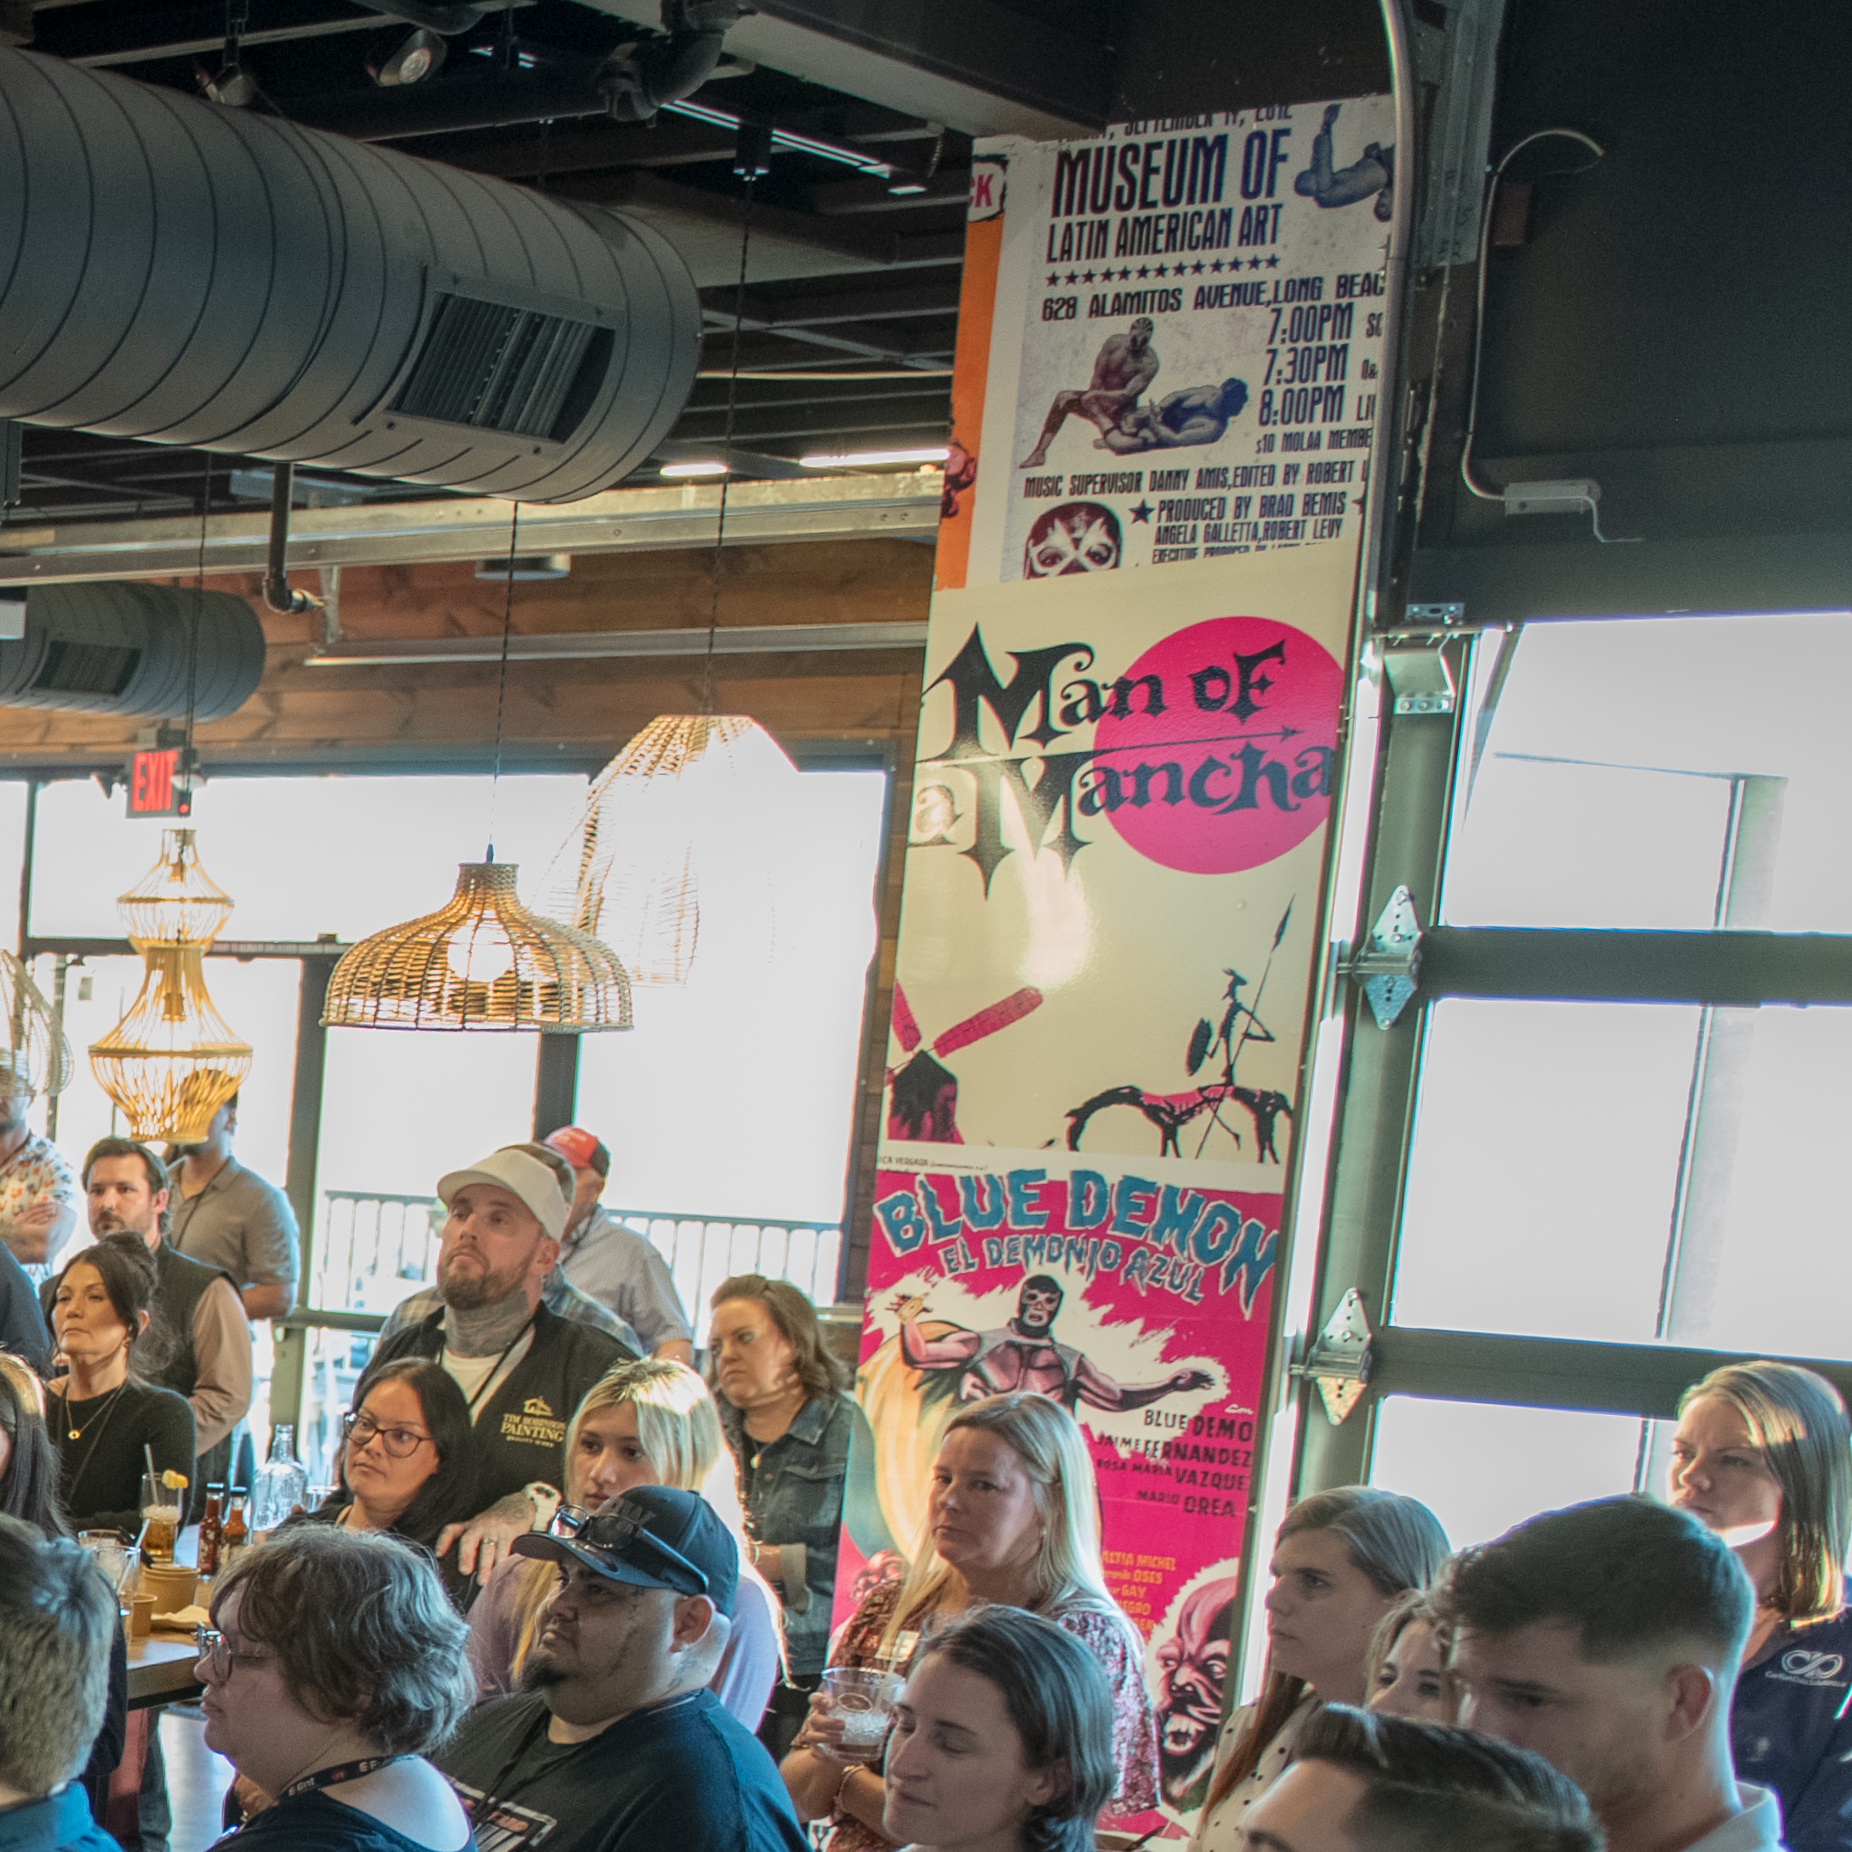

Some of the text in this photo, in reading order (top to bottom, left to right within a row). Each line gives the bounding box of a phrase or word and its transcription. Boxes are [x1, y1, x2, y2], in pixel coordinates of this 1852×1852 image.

[1051, 127, 1293, 218] MUSEUM OF
[1046, 203, 1284, 264] LATIN AMERICAN ART
[1041, 296, 1078, 322] 628
[1088, 288, 1184, 318] ALAMITOS
[1267, 302, 1355, 345] 7:00PM
[1263, 343, 1350, 386] 7:30PM
[1258, 384, 1346, 427] 8:00PM
[1281, 430, 1321, 453] MOLAA
[1023, 476, 1063, 499] MUSIC
[1069, 471, 1143, 497] SUPERVISOR
[1149, 469, 1190, 493] DANNY
[1282, 463, 1300, 486] BY
[1306, 460, 1356, 485] ROBERT
[1157, 497, 1228, 523] PRODUCED
[1234, 495, 1252, 519] BY
[1259, 494, 1293, 518] BRAD
[1154, 522, 1197, 546] ANGELA
[1312, 518, 1343, 540] LEVY
[918, 621, 1170, 763] Man
[131, 750, 178, 812] EXIT
[957, 741, 1332, 901] Mancha
[873, 1168, 1279, 1321] BLUE DEMON
[938, 1233, 1205, 1306] EL DEMONIO AZUL
[500, 1422, 565, 1443] PAINTING
[1143, 1409, 1188, 1430] BLUE
[1097, 1433, 1253, 1468] JAIME FERNANDEZ
[1097, 1459, 1249, 1491] ROSA MARIA VAZQUE
[1138, 1490, 1235, 1518] MARIO OREA
